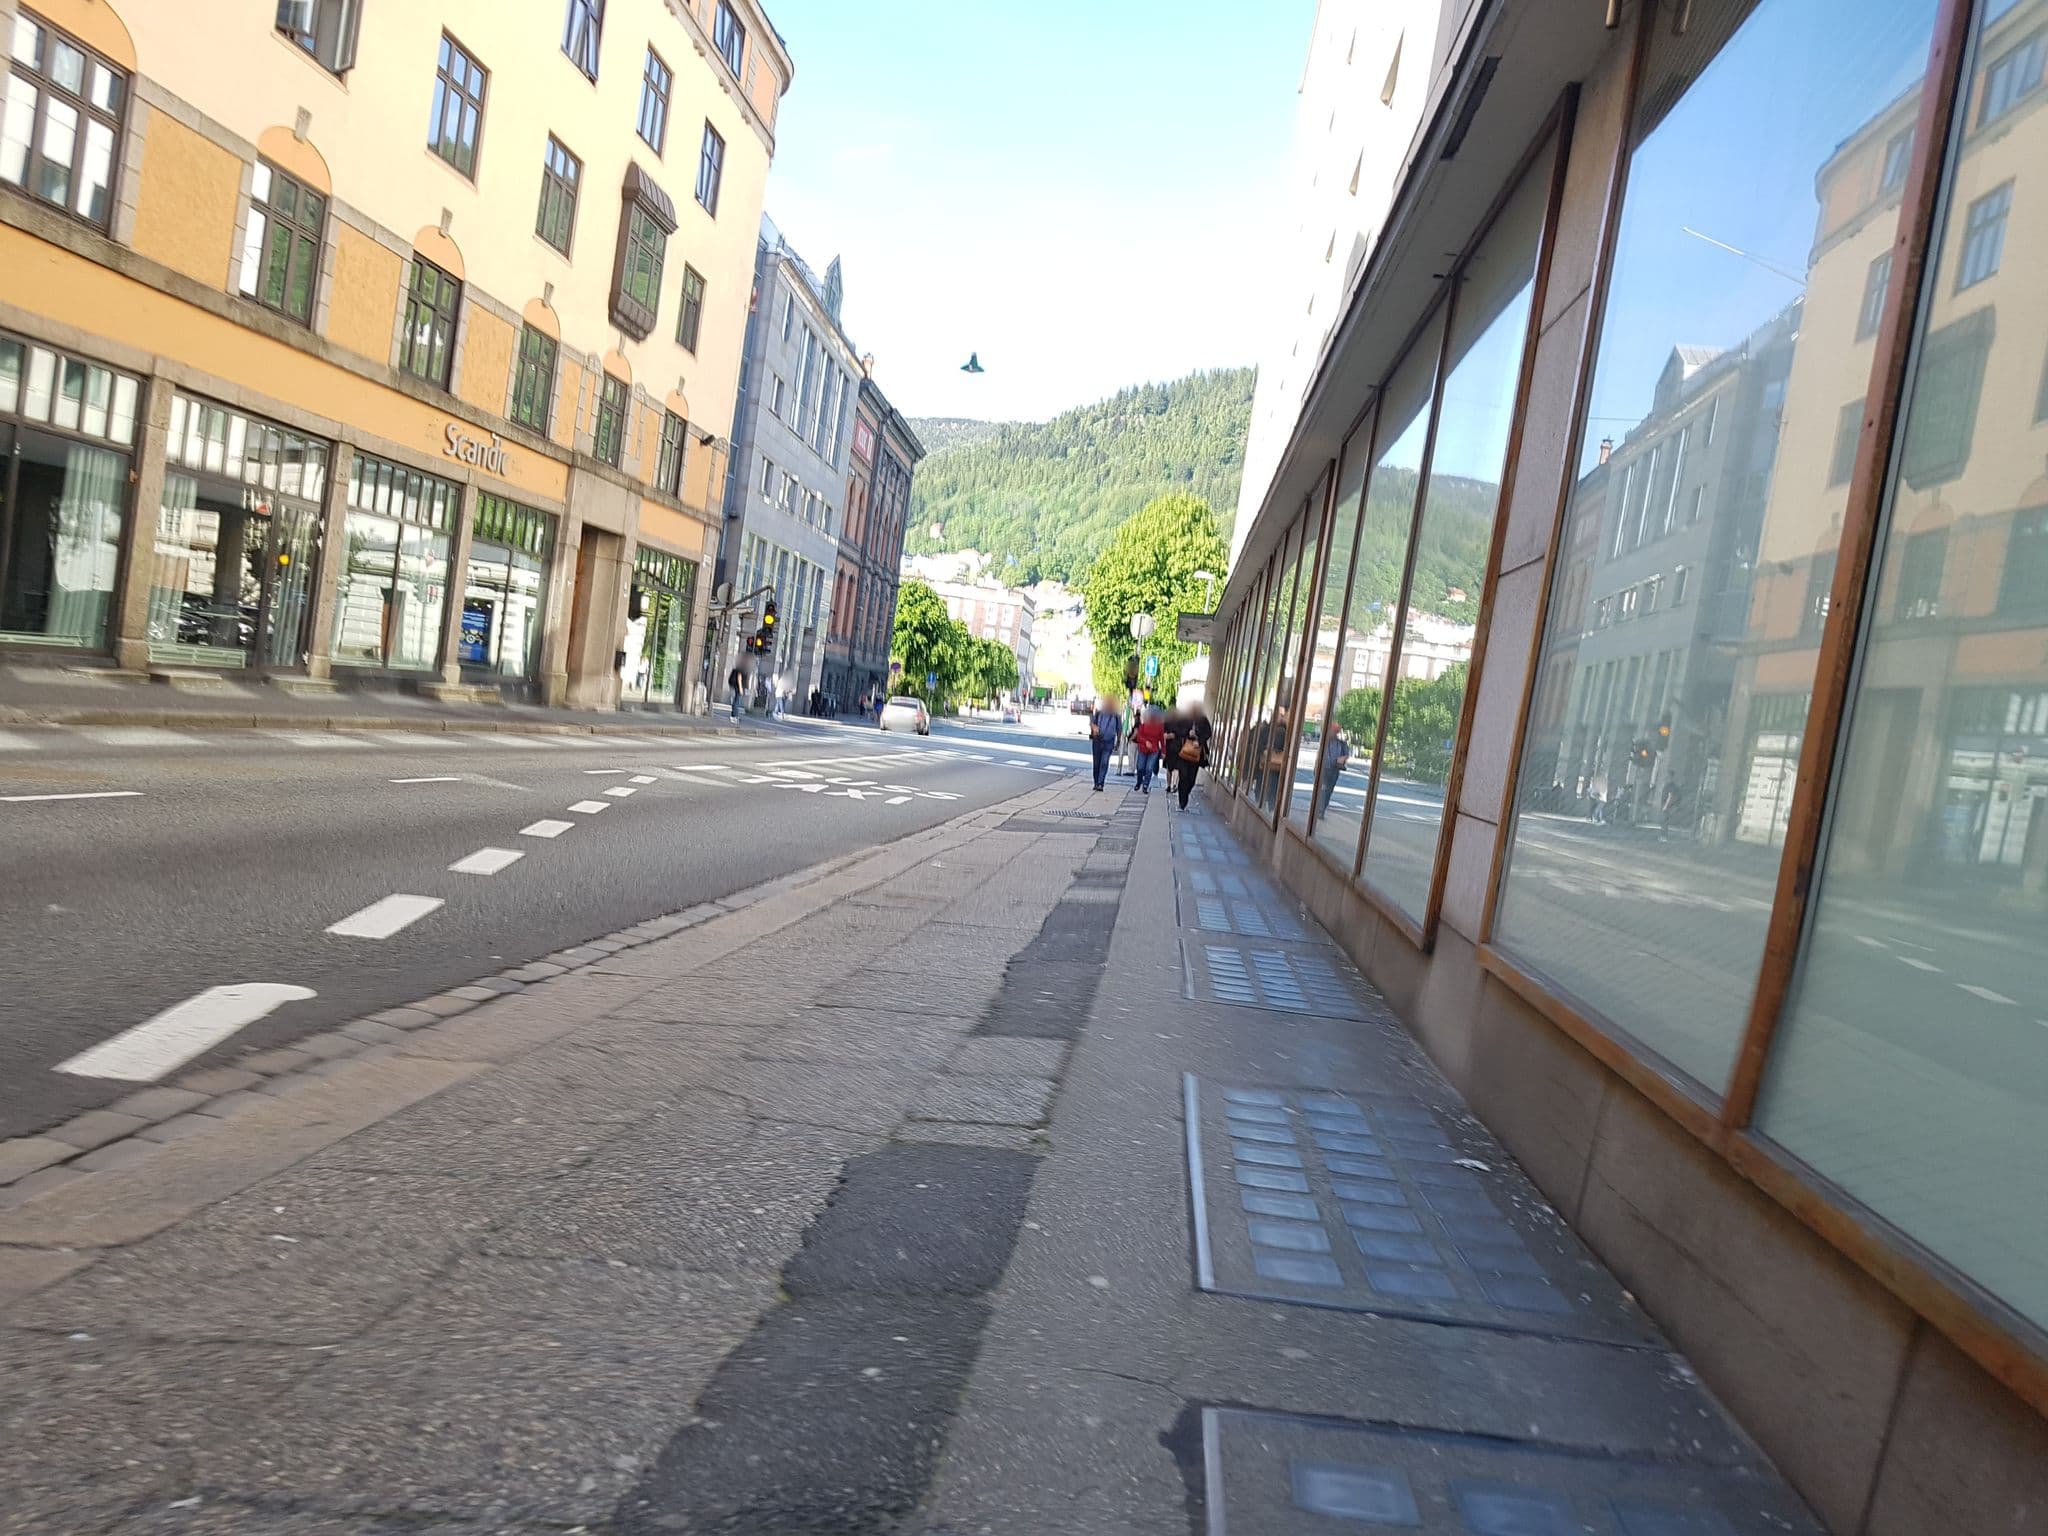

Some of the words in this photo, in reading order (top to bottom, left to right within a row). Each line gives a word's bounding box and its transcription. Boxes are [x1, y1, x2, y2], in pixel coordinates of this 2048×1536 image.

[443, 422, 511, 476] Scandic
[737, 775, 914, 805] TAXI
[767, 770, 966, 800] BUSS
